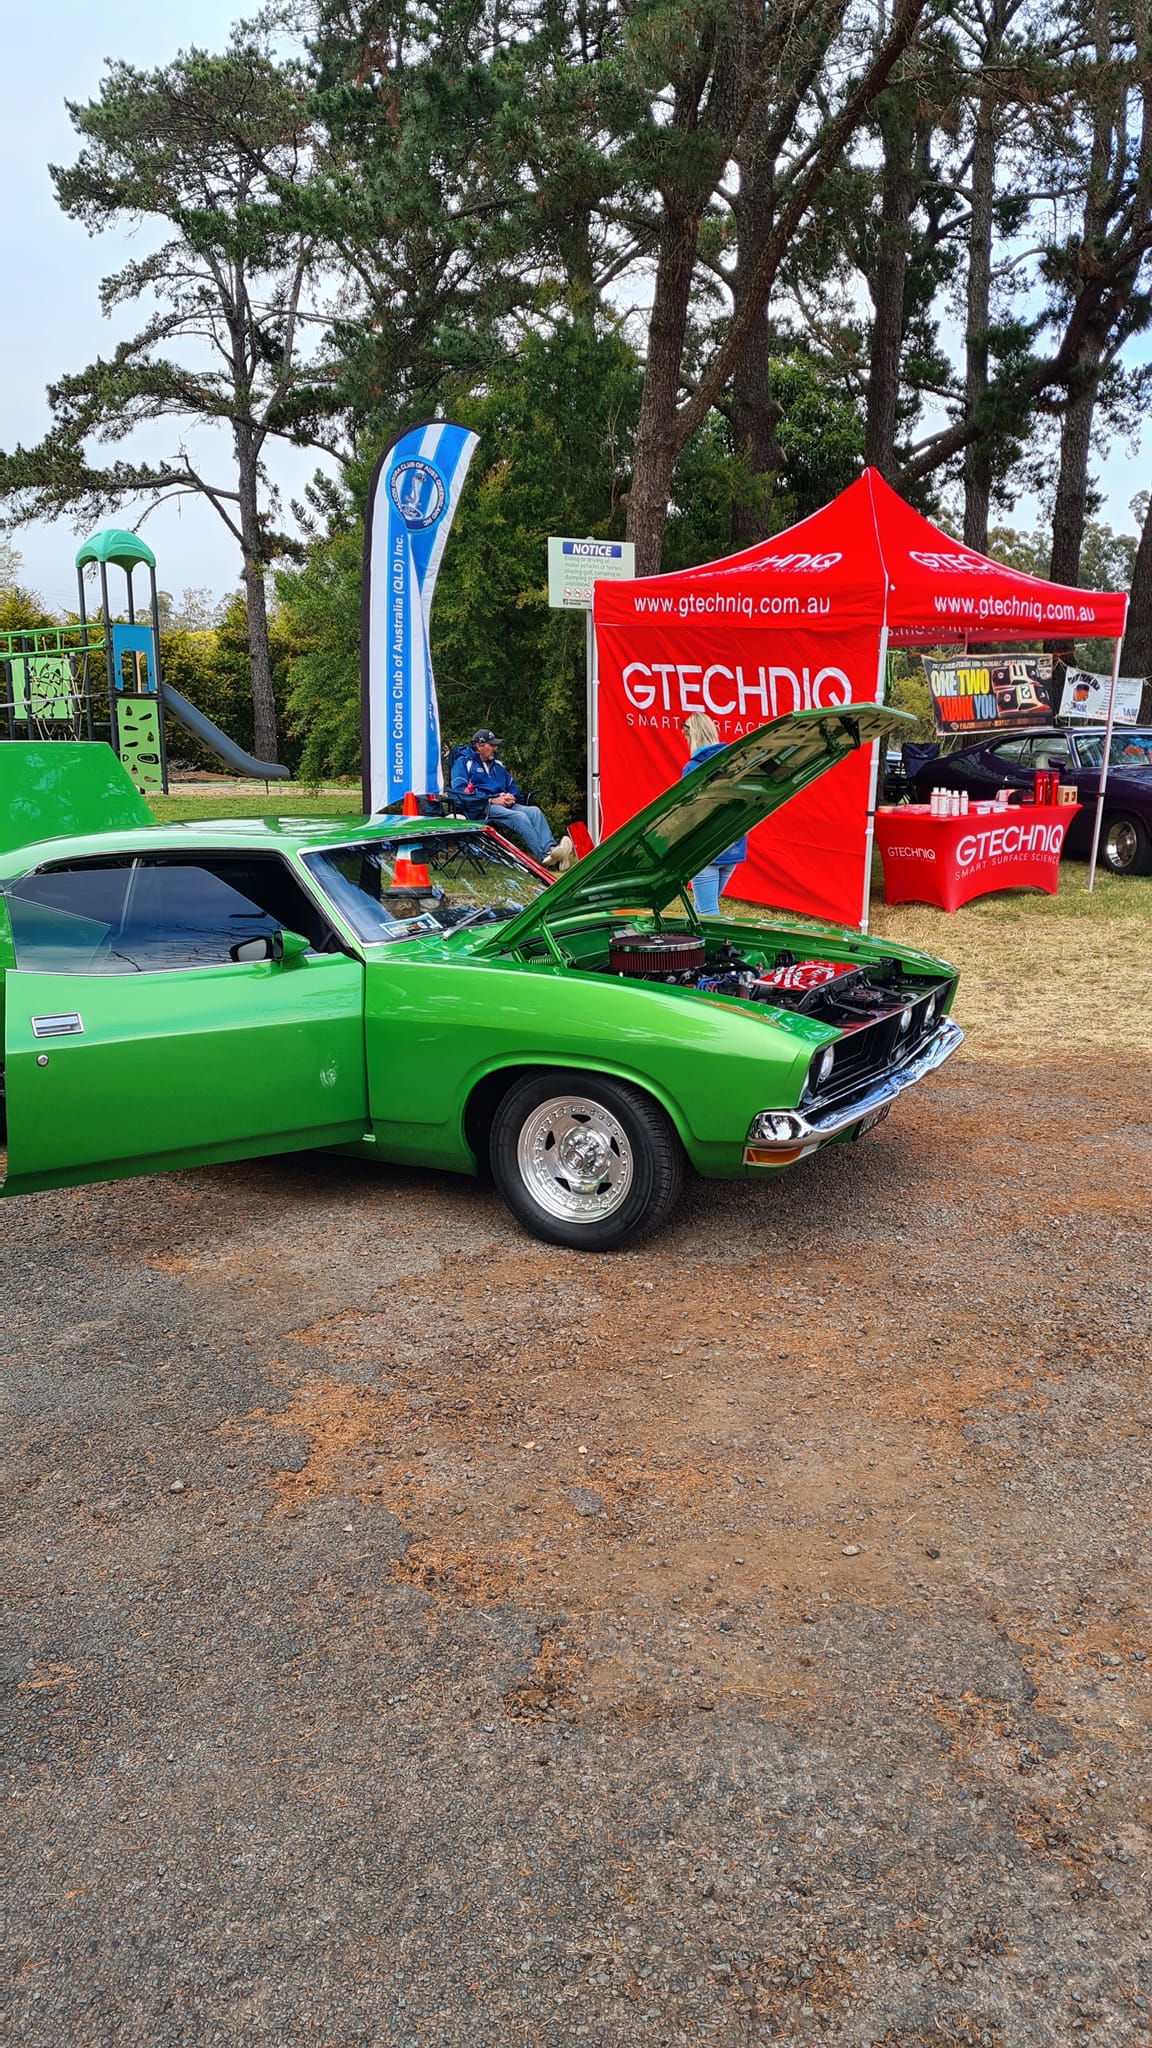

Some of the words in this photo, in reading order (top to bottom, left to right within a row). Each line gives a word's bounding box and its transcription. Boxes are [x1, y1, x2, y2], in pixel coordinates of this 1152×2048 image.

[393, 534, 404, 556] Inc.
[573, 543, 612, 556] NOTICE
[393, 559, 405, 594] (QLD)
[634, 592, 831, 619] www.gtechniq.com.au
[934, 595, 1096, 623] www.gtechniq.com.au
[393, 598, 403, 653] Australia
[393, 654, 403, 667] of
[393, 670, 403, 699] Club
[622, 661, 852, 717] GTECHNIQ
[930, 670, 957, 697] ONE
[957, 668, 990, 696] TWO
[393, 702, 403, 739] Cobra
[936, 696, 975, 722] THANK
[974, 694, 997, 720] YOU
[626, 713, 680, 729] SMART
[715, 719, 763, 735] RFAC
[393, 743, 403, 783] Falcon
[887, 846, 936, 860] GTECHNIQ
[955, 824, 1064, 867] GTECHNIQ
[954, 862, 988, 881] SMART
[991, 853, 1028, 866] SURFACE
